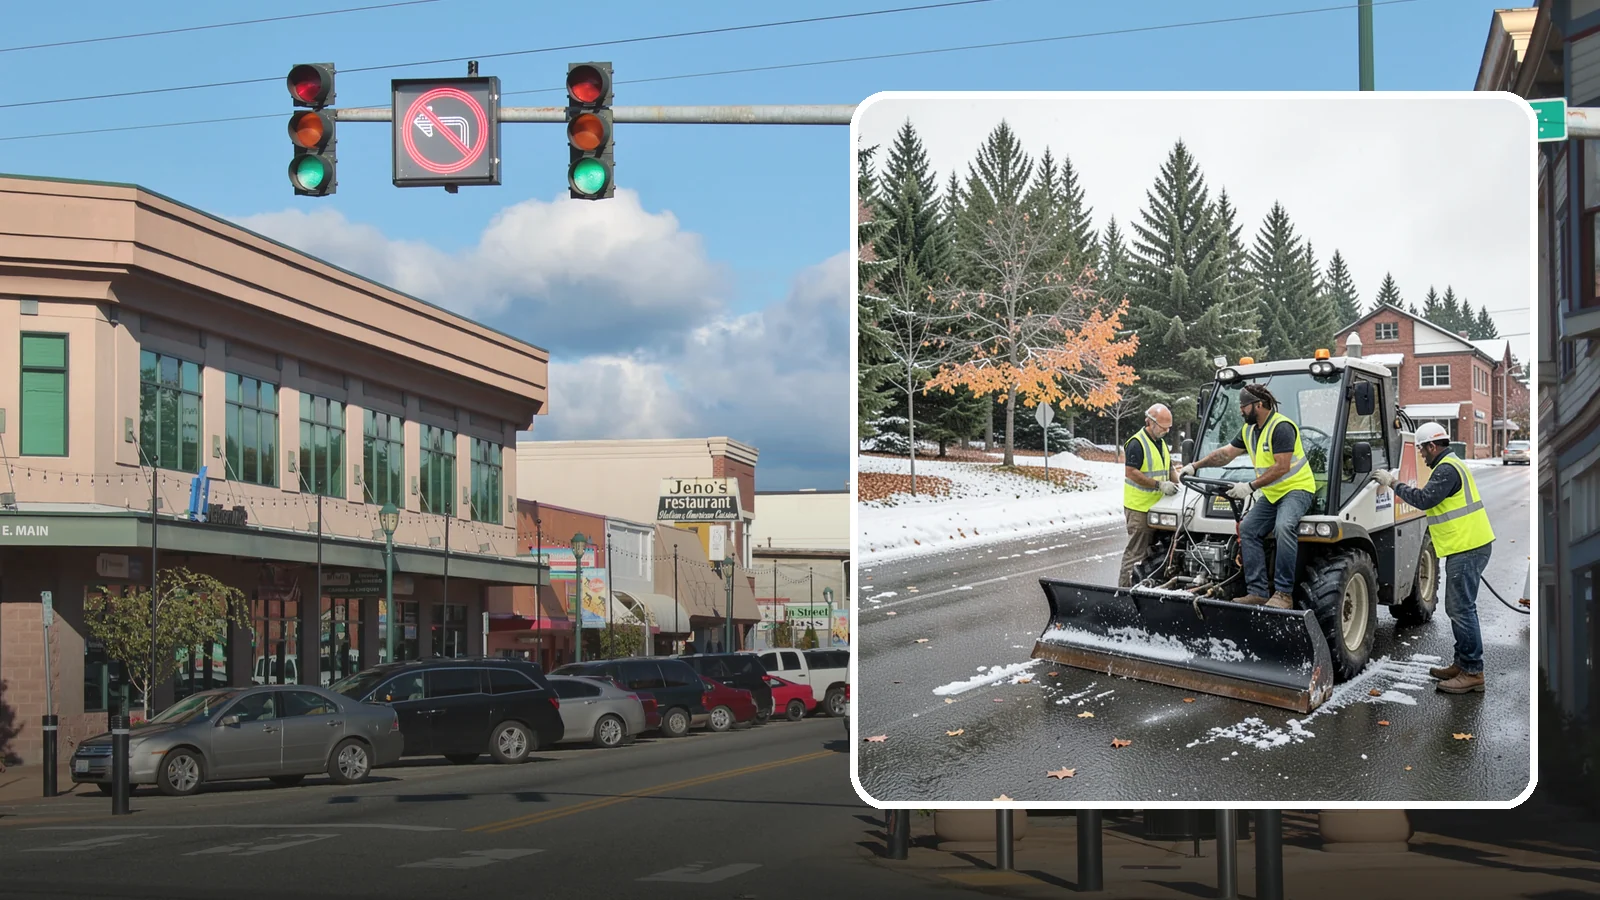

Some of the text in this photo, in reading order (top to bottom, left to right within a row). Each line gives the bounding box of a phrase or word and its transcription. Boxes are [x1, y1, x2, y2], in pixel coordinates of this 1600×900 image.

[670, 480, 727, 495] Jeno's
[665, 496, 731, 509] restaurant
[686, 509, 714, 519] American
[715, 509, 738, 519] Cuisine
[2, 525, 49, 537] E. MAIN
[797, 607, 829, 617] Street
